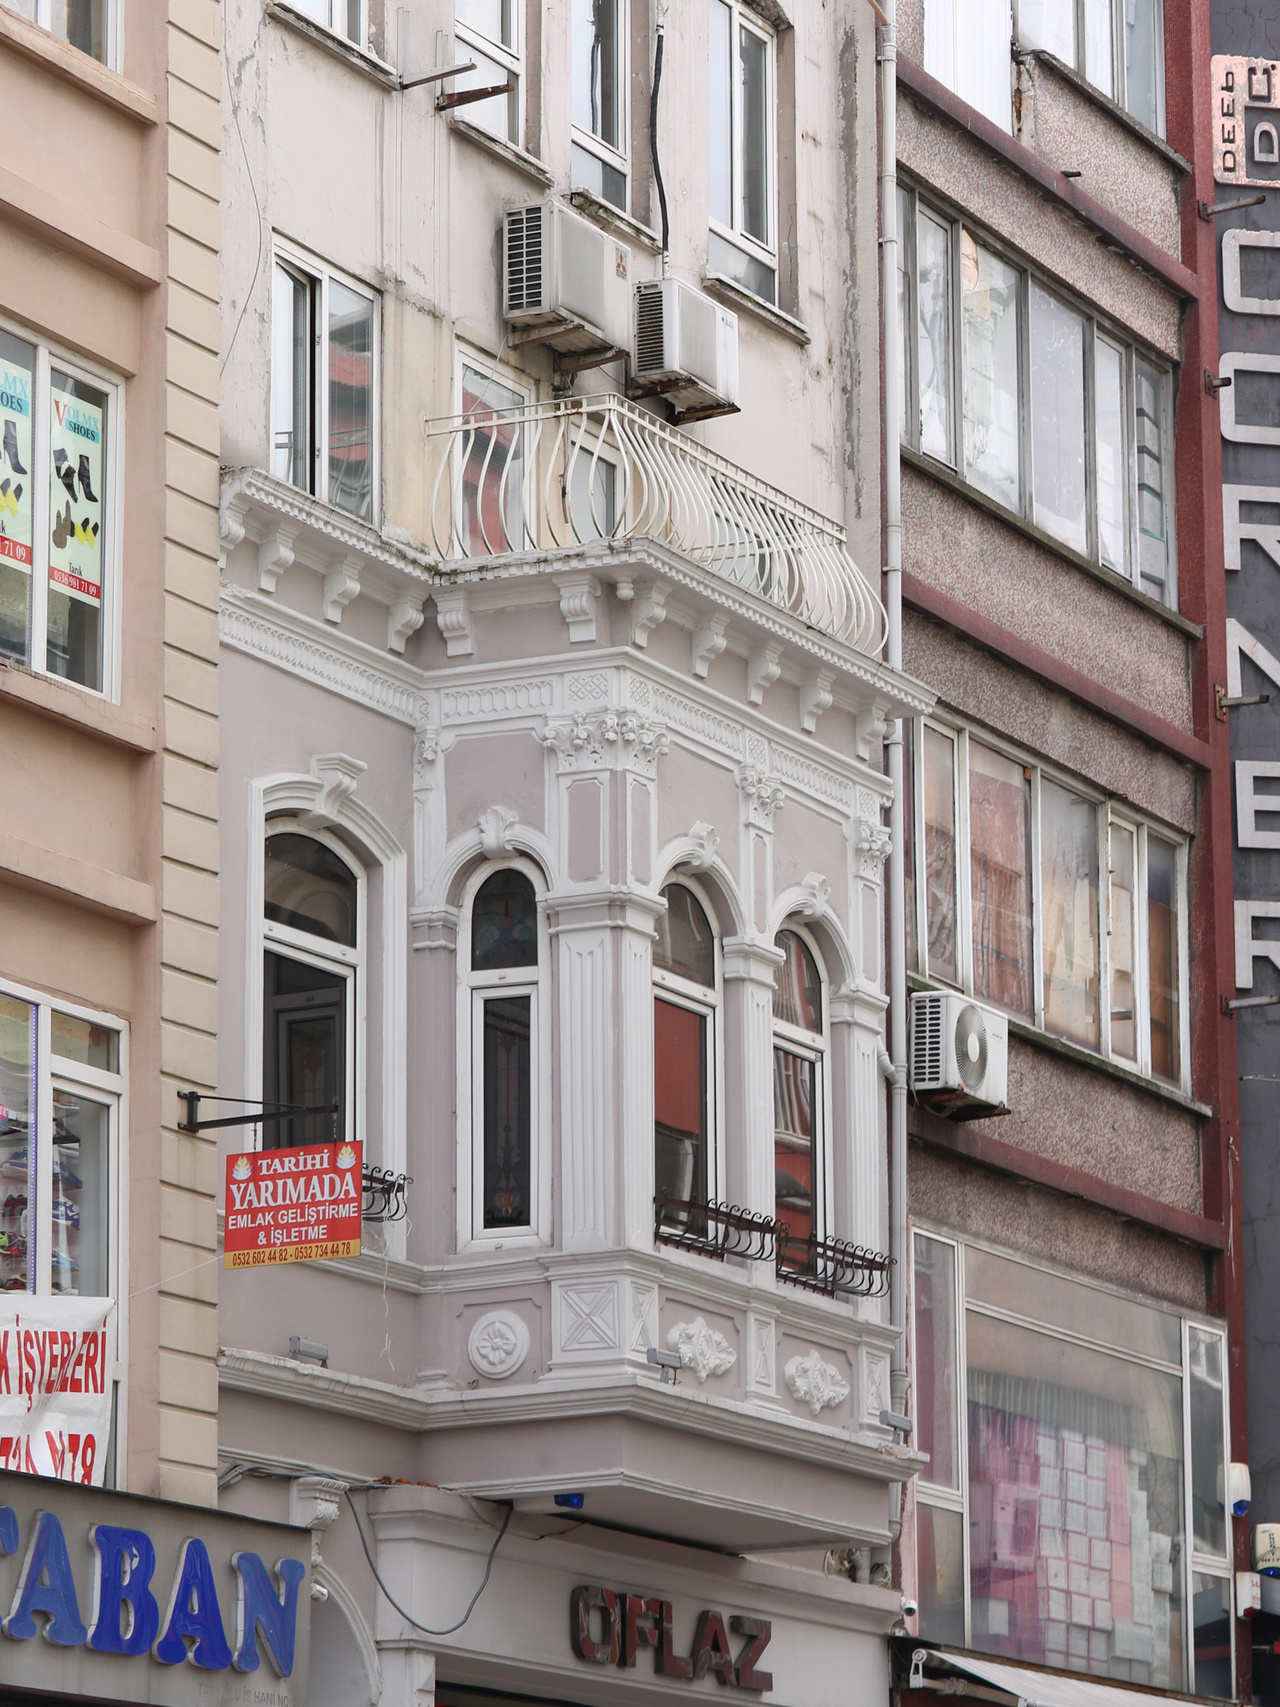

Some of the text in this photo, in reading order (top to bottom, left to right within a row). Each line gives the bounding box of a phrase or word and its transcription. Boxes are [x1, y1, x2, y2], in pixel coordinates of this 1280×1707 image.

[1221, 71, 1236, 172] DEEP
[53, 398, 99, 432] VOLMX
[68, 420, 96, 442] SHOES
[257, 1148, 330, 1176] TARİHİ
[230, 1171, 357, 1211] YARIMADA
[228, 1202, 358, 1230] EMLAK GELİŞTİRME
[257, 1225, 328, 1247] & İŞLETME
[232, 1251, 250, 1266] 0532
[252, 1251, 266, 1264] 602
[267, 1250, 277, 1263] 44
[278, 1248, 288, 1261] 82
[294, 1245, 313, 1260] 0532
[314, 1243, 328, 1258] 734
[329, 1242, 340, 1256] 44
[341, 1241, 351, 1255] 78
[571, 1585, 774, 1692] OFLAZ
